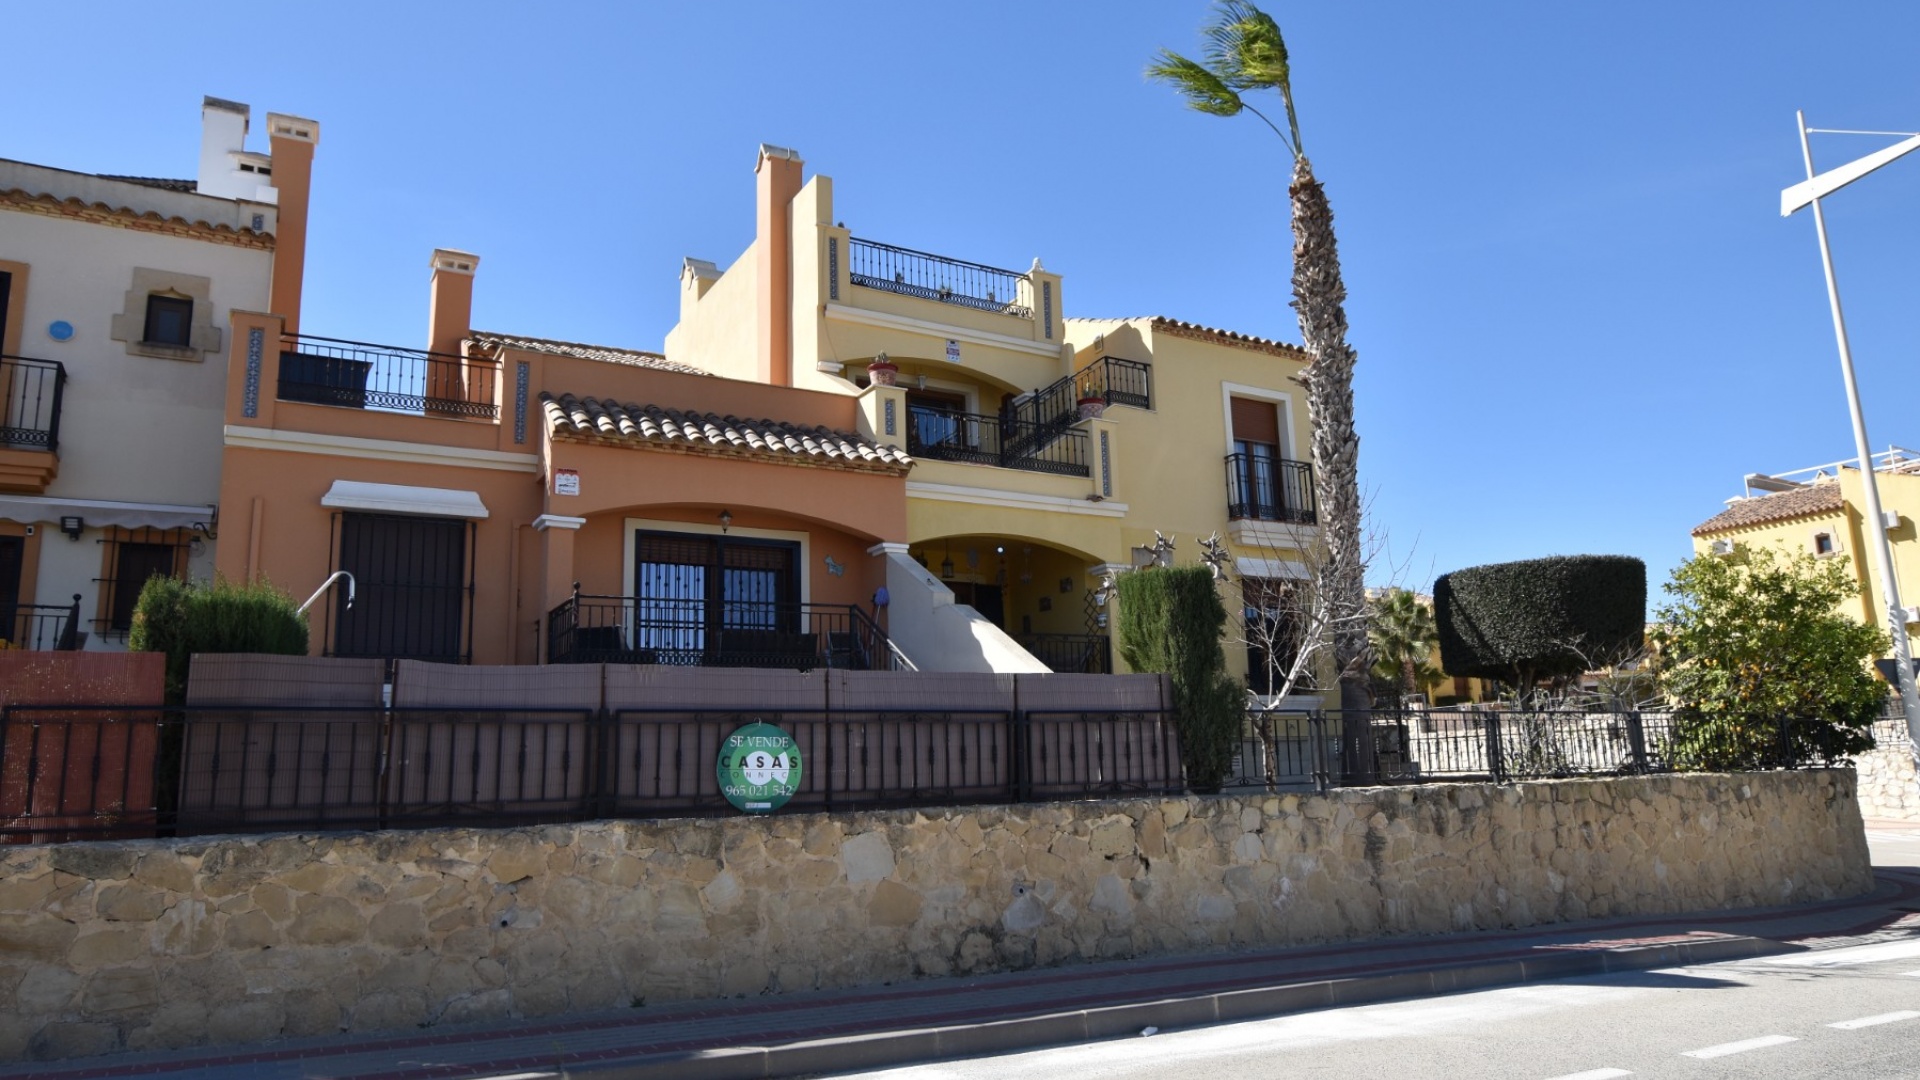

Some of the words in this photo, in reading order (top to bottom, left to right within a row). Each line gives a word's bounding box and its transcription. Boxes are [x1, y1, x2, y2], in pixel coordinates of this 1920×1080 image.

[730, 736, 744, 747] SE
[746, 736, 789, 748] VENDE
[721, 756, 798, 768] CASAS
[720, 771, 798, 779] CONNECT
[725, 785, 746, 796] 965
[749, 785, 768, 796] 021
[772, 785, 792, 796] 542
